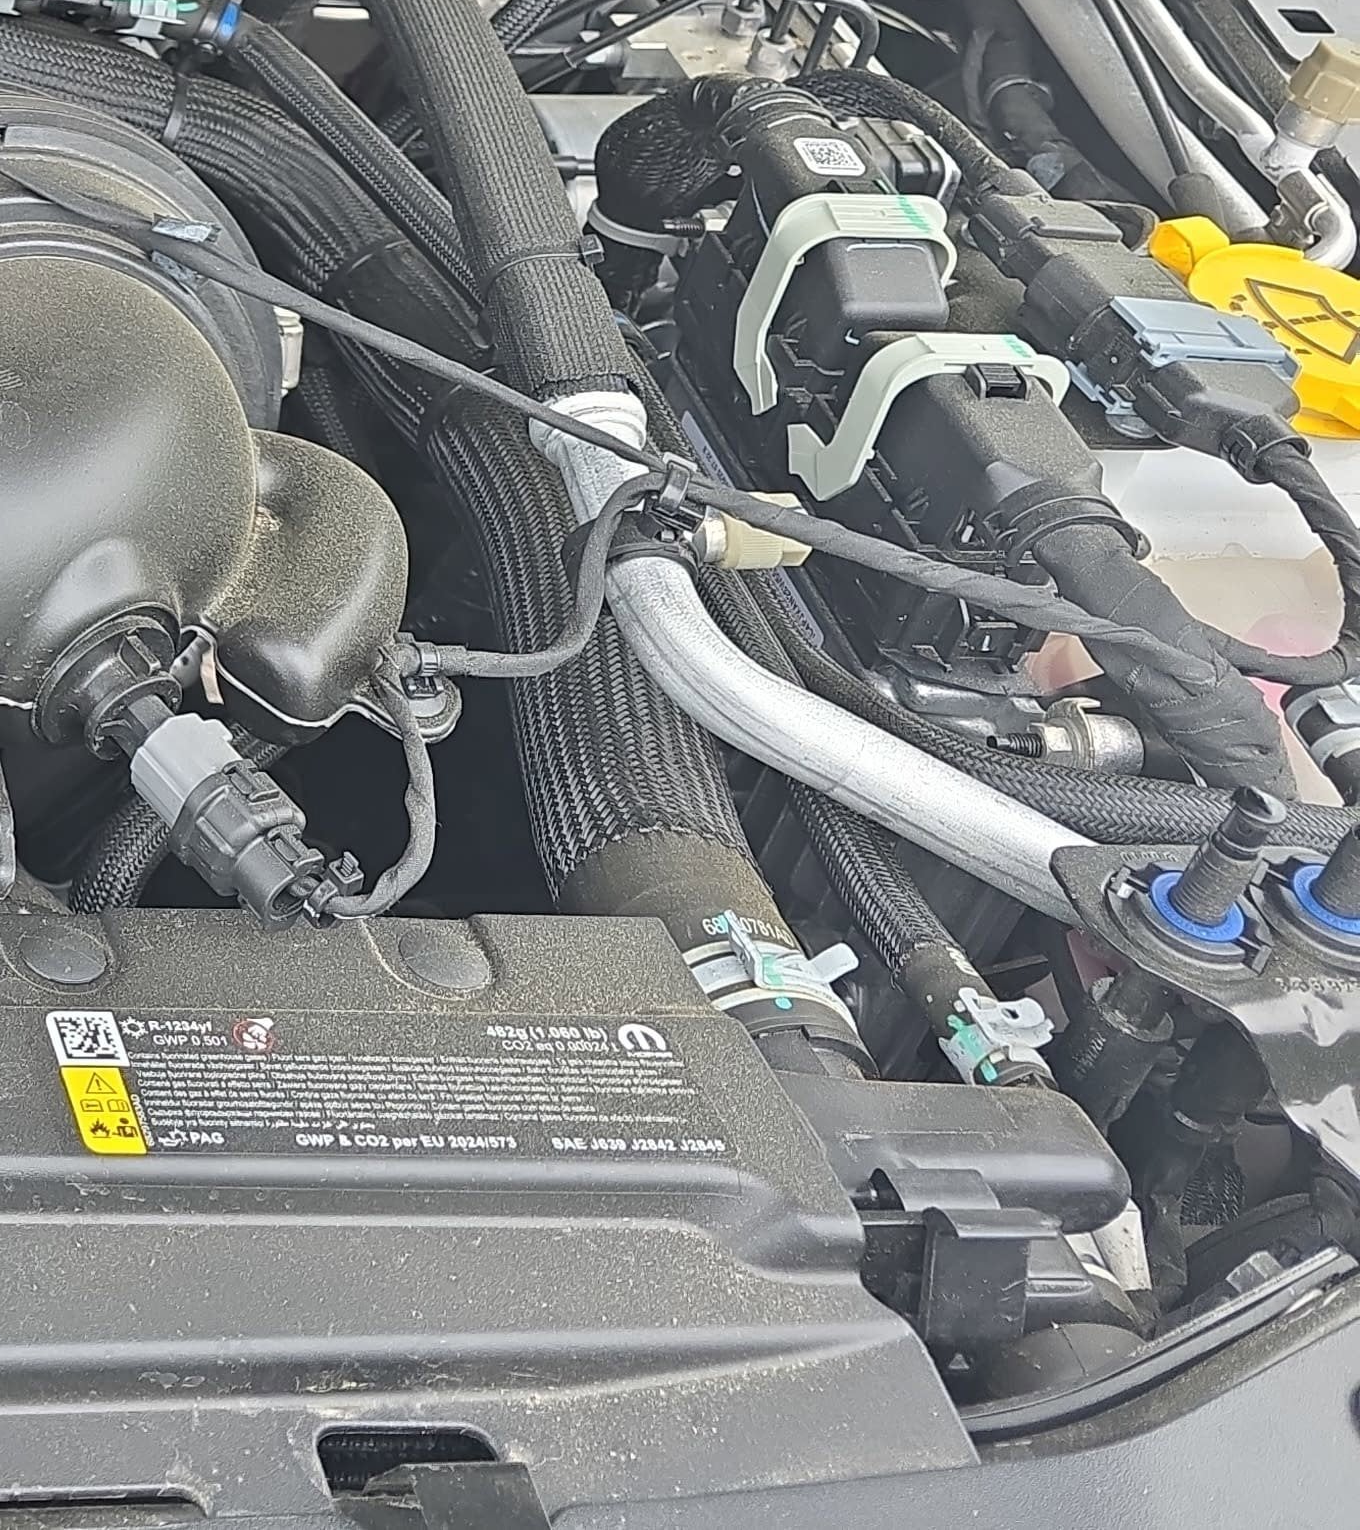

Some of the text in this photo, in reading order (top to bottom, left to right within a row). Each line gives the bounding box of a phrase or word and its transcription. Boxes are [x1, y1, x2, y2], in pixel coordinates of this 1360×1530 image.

[701, 916, 795, 948] 680781AD
[152, 1034, 228, 1047] GWP 0.501
[486, 1025, 529, 1041] 482g
[501, 1040, 533, 1051] CO2
[190, 1131, 225, 1145] PAG
[295, 1134, 335, 1147] GWP
[354, 1134, 390, 1147] CO2
[392, 1136, 418, 1150] per
[420, 1135, 445, 1148] EU
[447, 1135, 518, 1150] 2024/573
[551, 1136, 726, 1152] SAE J639 J2842 J2845
